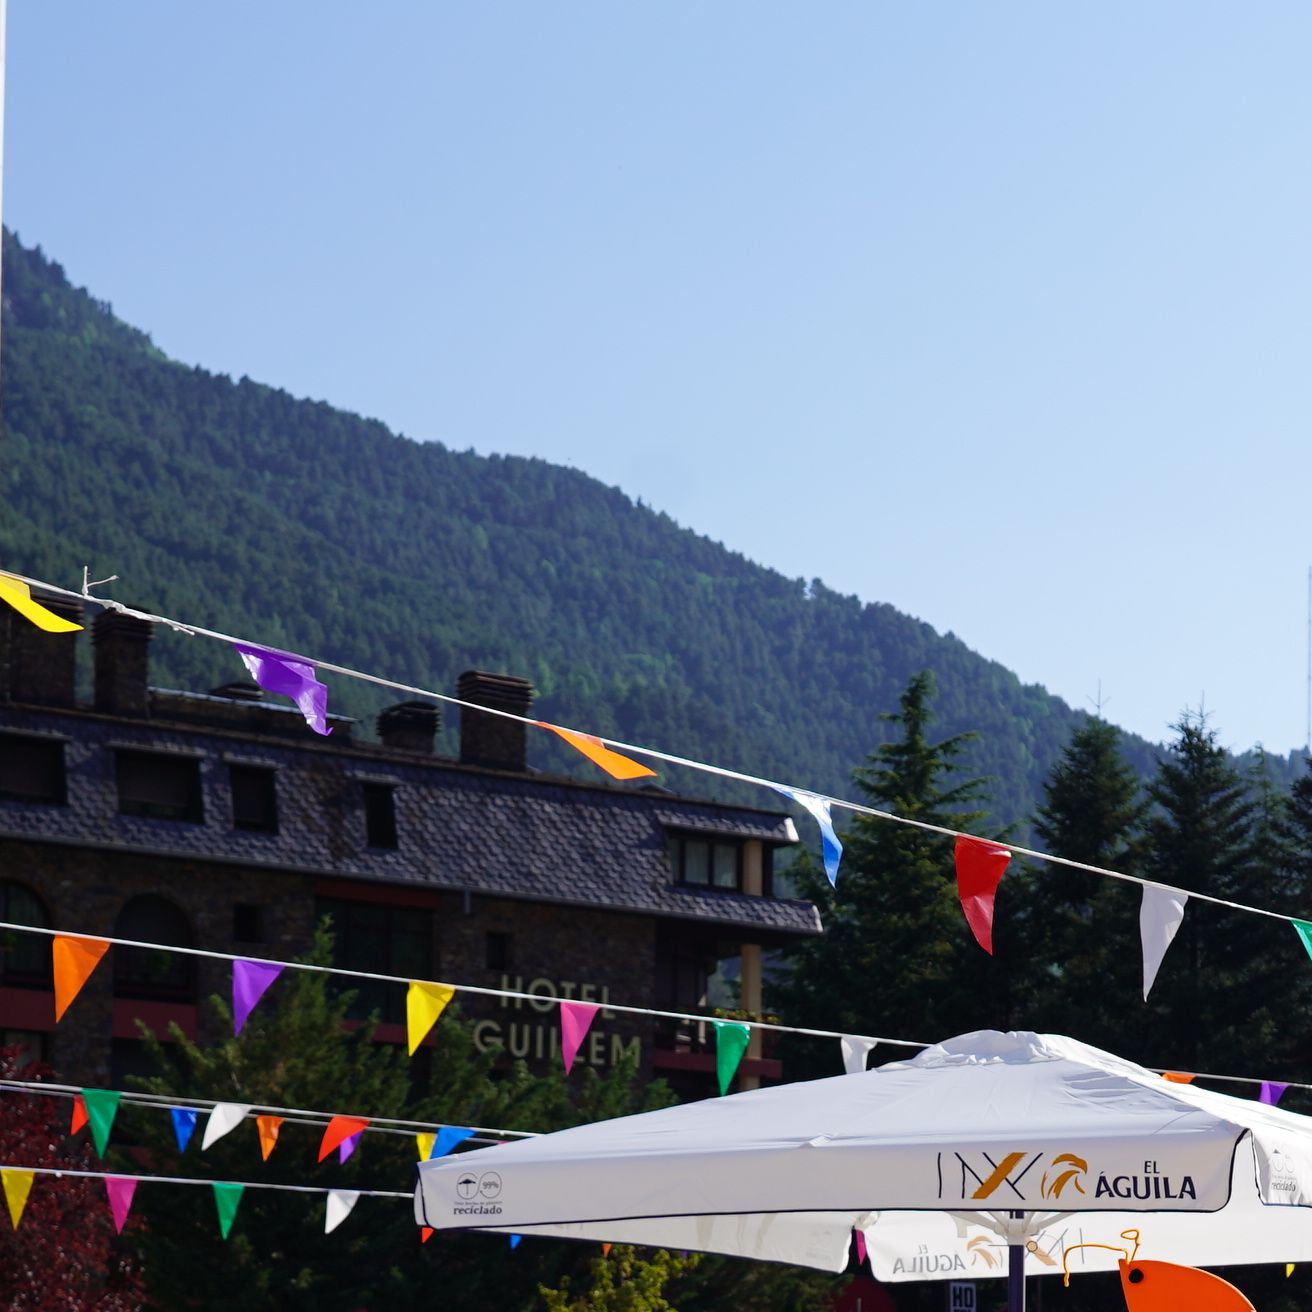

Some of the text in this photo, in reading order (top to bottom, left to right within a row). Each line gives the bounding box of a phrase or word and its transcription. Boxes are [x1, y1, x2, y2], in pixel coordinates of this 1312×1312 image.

[473, 1019, 641, 1068] GUILEM
[1144, 1160, 1160, 1174] EL
[1095, 1171, 1197, 1200] ÁGUILA
[453, 1205, 503, 1215] reciclado
[952, 1286, 974, 1308] HO
